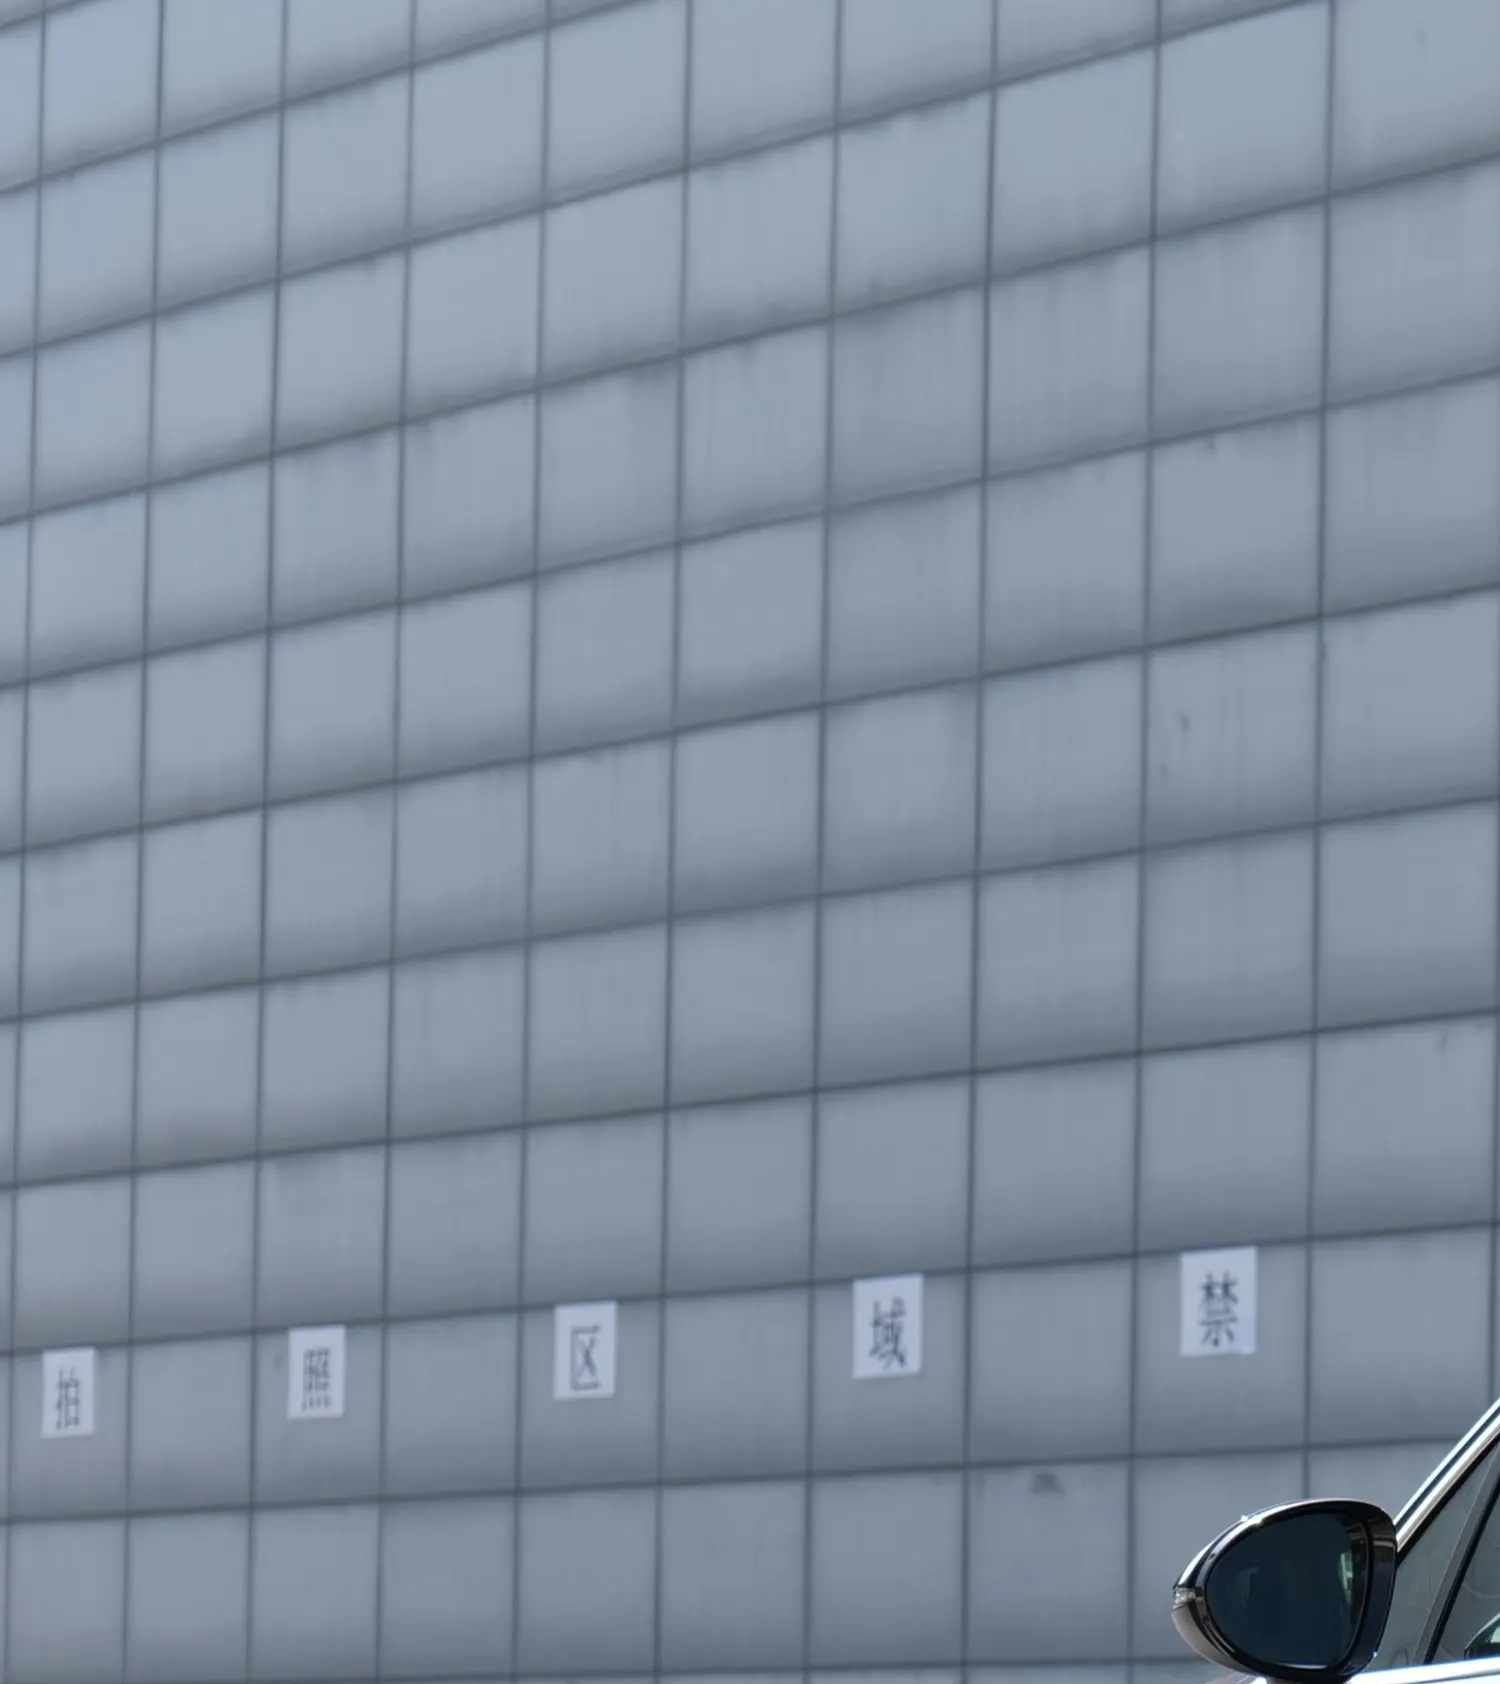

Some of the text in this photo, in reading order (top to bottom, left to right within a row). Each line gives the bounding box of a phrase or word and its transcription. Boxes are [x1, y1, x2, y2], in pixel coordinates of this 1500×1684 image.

[302, 1347, 332, 1411] 照
[570, 1325, 601, 1391] 区
[869, 1297, 906, 1369] 域
[1200, 1271, 1239, 1347] 禁
